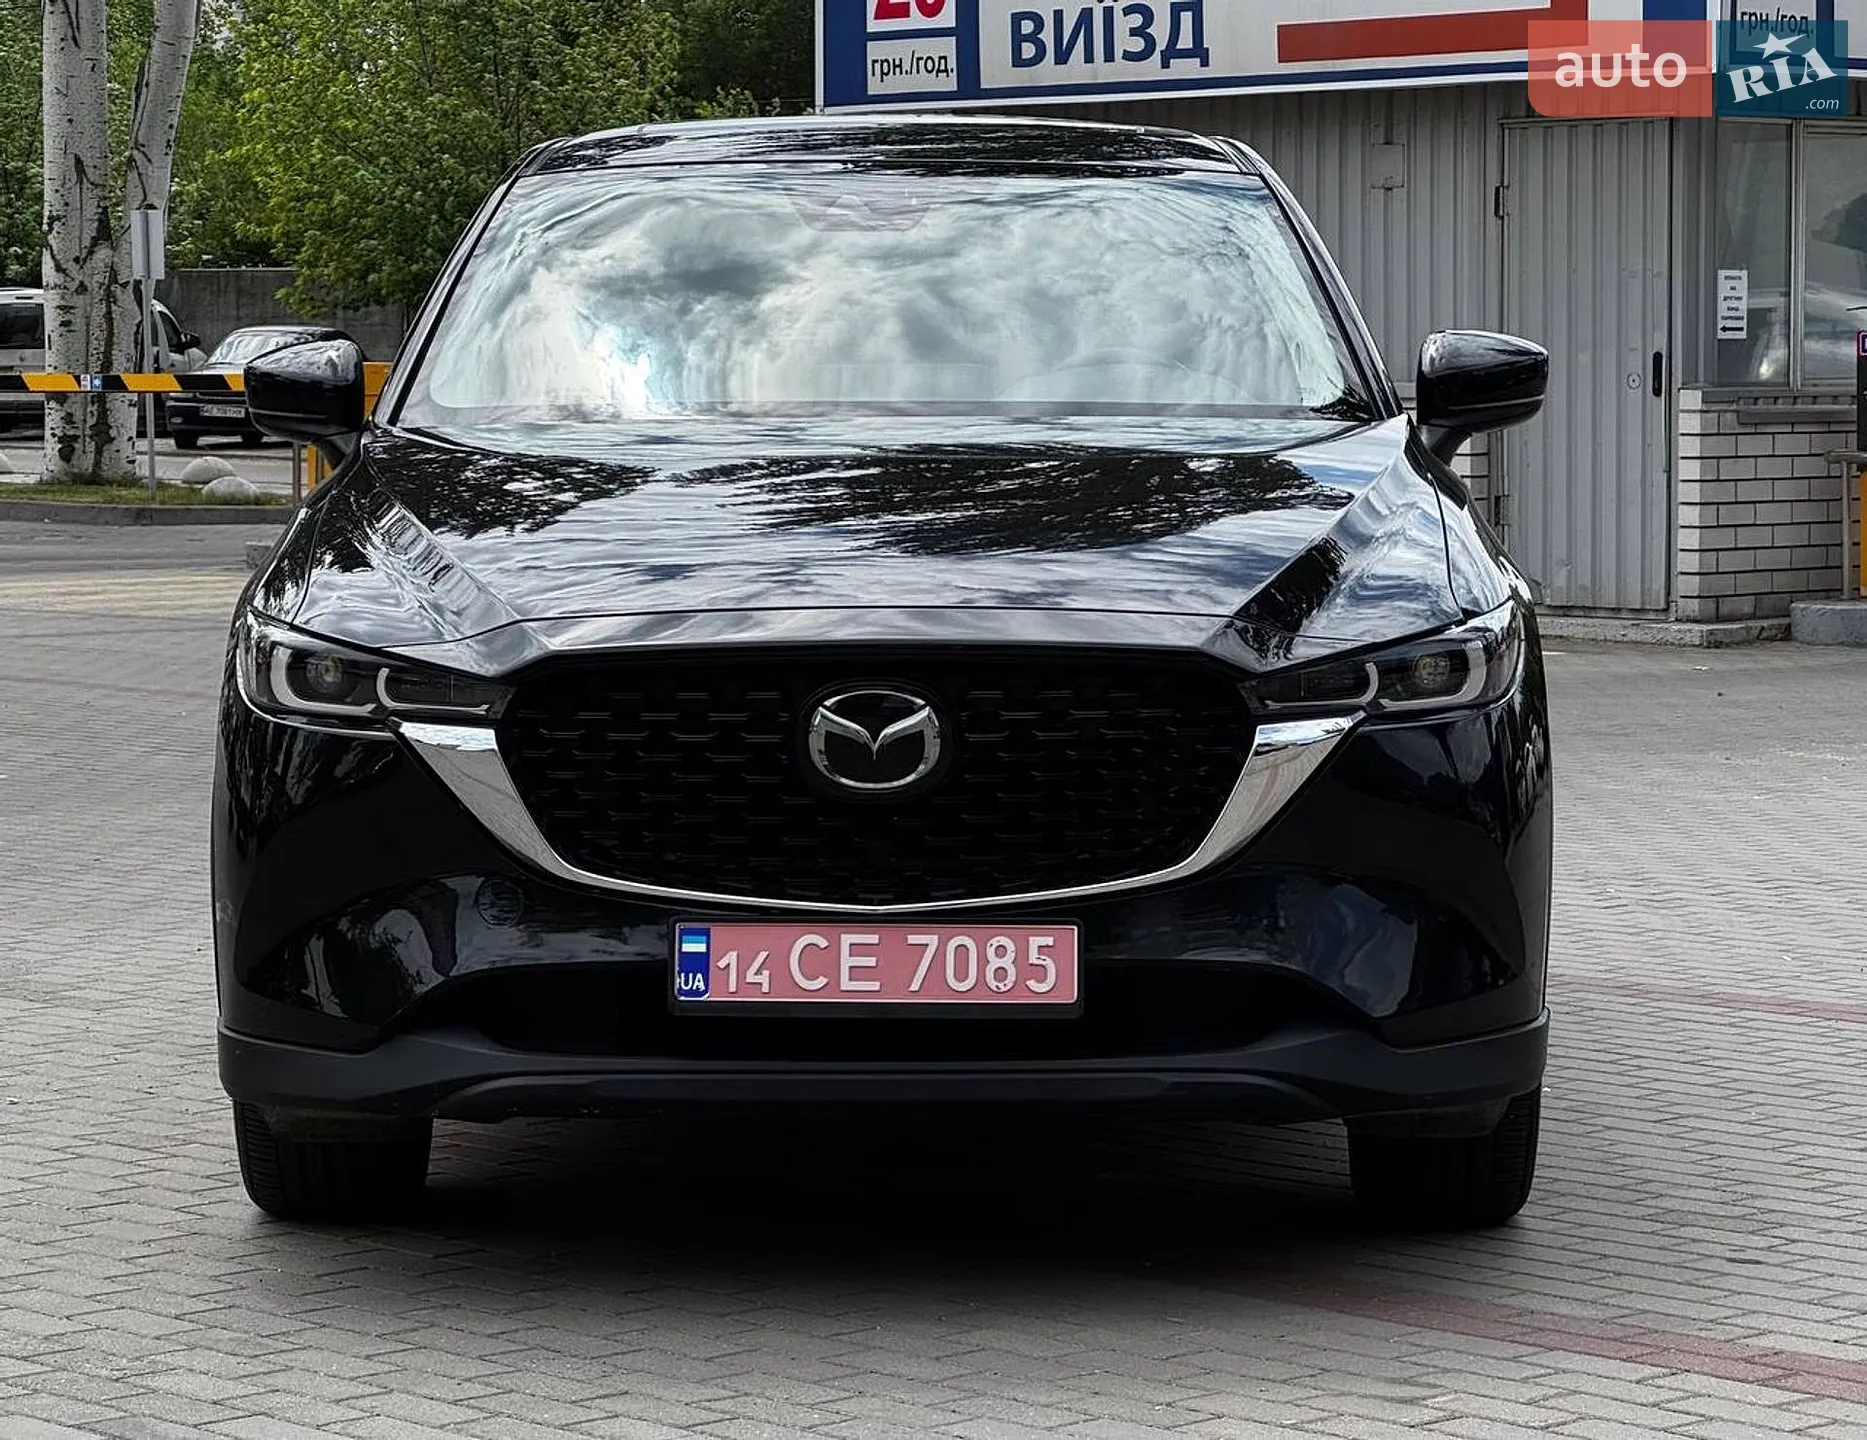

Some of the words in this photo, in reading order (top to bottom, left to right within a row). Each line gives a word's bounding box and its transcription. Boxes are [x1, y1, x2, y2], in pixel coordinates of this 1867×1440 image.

[1010, 0, 1210, 69] ВИЇЗД
[871, 50, 954, 82] грн./год.
[681, 973, 706, 991] UA
[716, 950, 770, 993] 14
[789, 934, 881, 992] CE
[907, 934, 1057, 993] 7085
